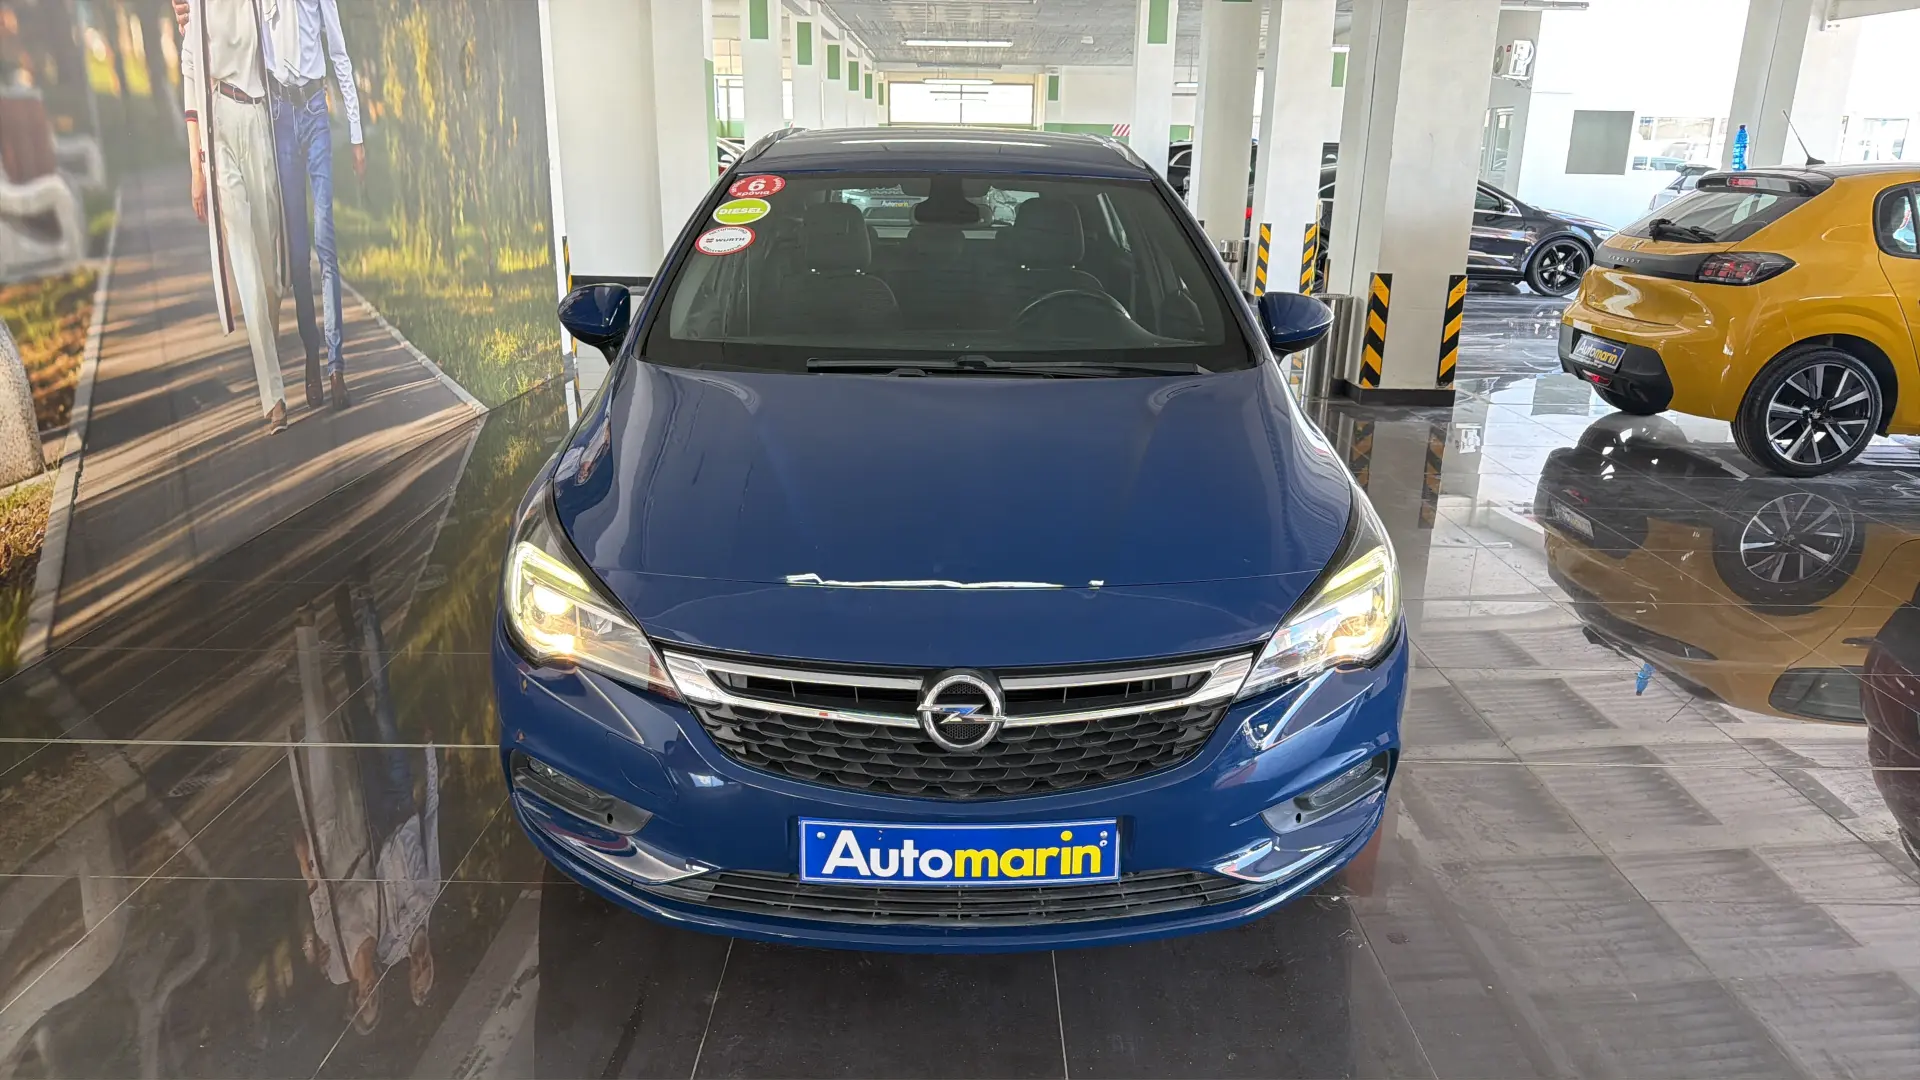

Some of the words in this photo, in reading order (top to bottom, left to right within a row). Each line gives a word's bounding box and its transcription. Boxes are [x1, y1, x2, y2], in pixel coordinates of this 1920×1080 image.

[748, 180, 767, 191] 6
[718, 207, 764, 215] DIESEL
[1577, 339, 1618, 365] Automarin
[821, 829, 1101, 878] Automarin
